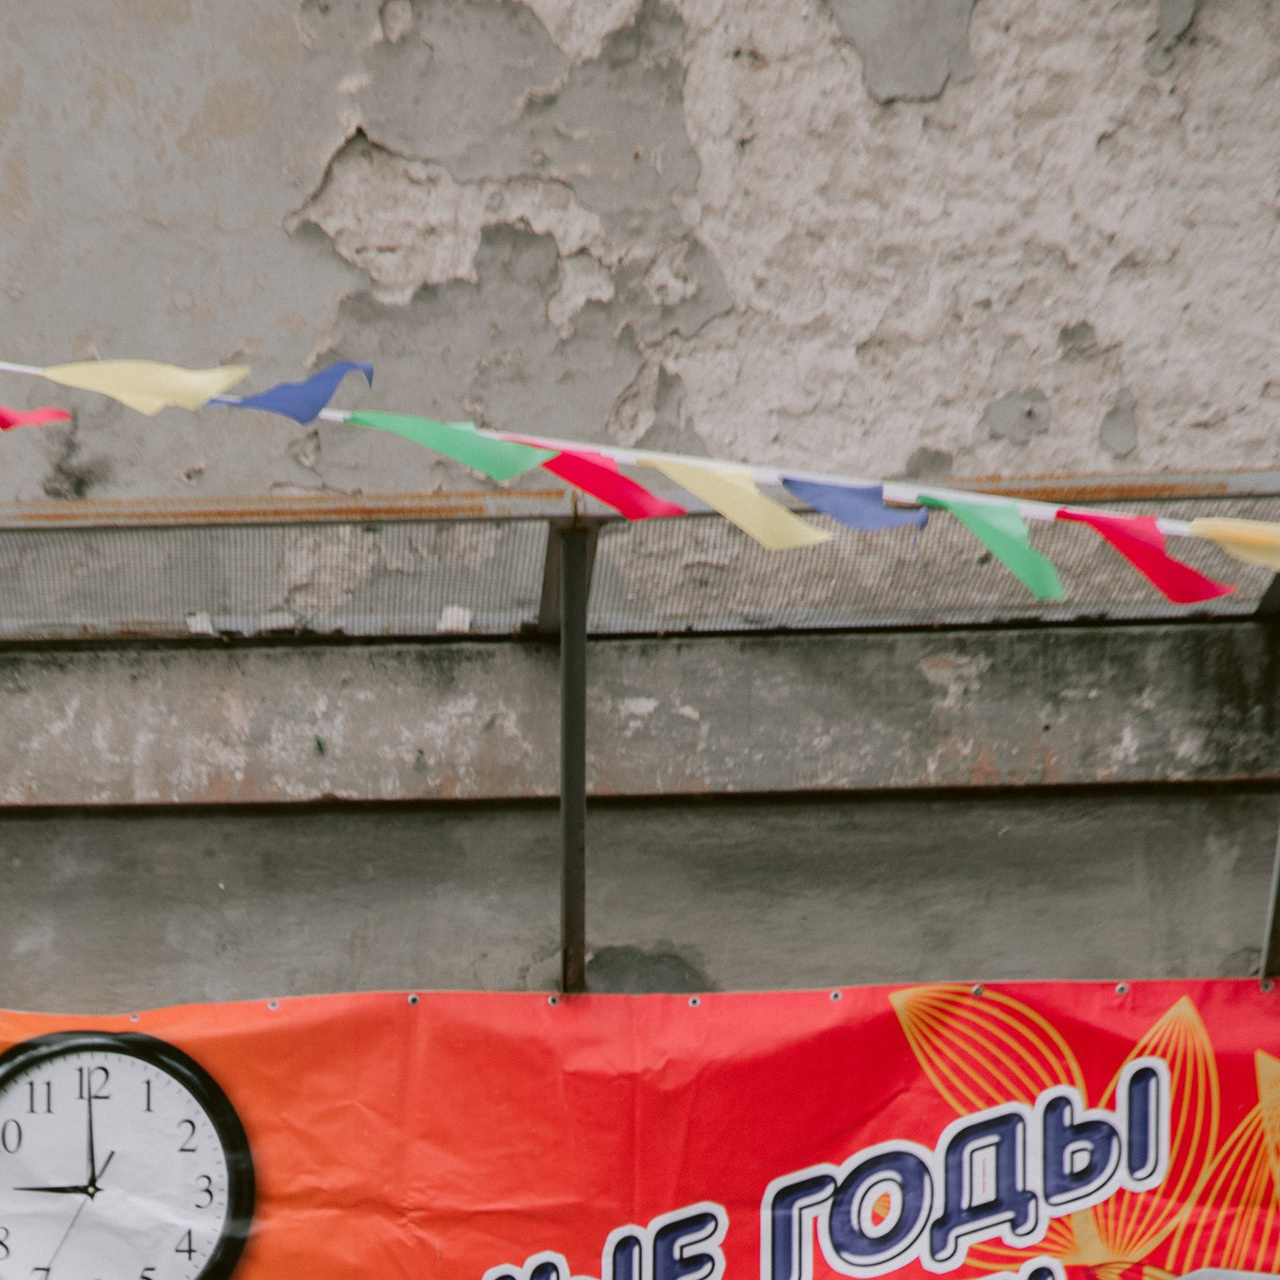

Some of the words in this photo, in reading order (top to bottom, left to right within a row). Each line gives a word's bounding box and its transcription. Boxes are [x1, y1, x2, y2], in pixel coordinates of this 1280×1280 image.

[27, 1080, 55, 1114] 11
[77, 1066, 110, 1100] 12
[145, 1078, 155, 1112] 1
[177, 1119, 197, 1152] 2
[195, 1175, 213, 1209] 3
[175, 1229, 196, 1261] 4
